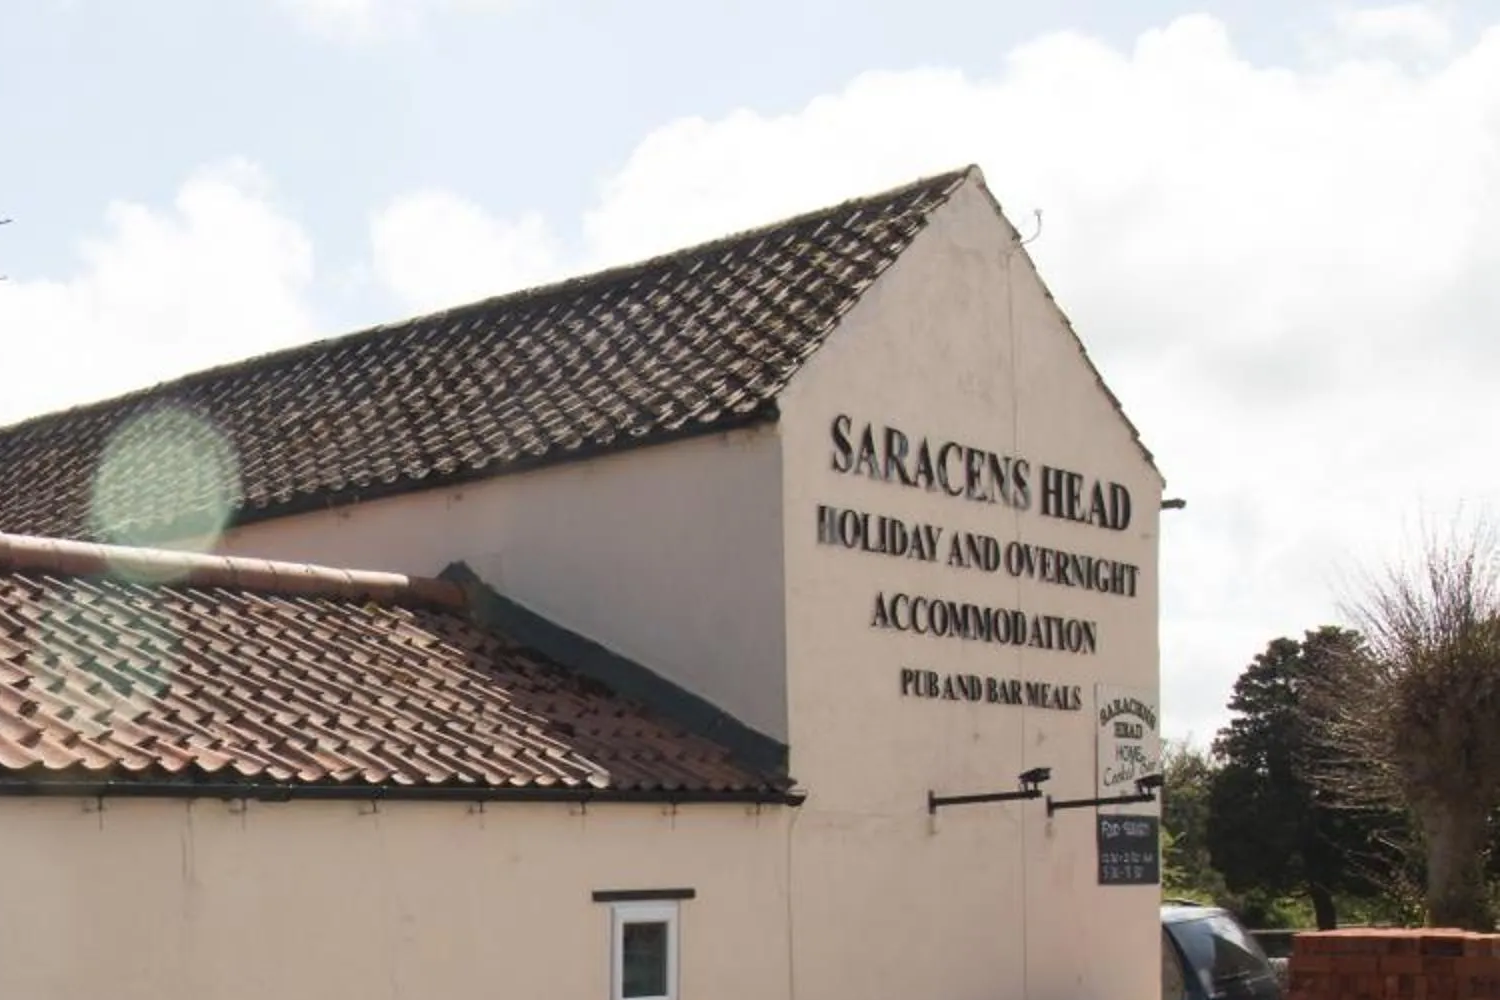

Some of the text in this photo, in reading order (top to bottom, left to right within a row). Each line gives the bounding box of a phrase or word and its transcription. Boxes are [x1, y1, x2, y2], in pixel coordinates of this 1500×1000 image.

[831, 414, 1132, 531] SARACENS HEAD
[817, 504, 1140, 597] HOLIDAY AND OVERNIGHT
[871, 592, 1097, 653] ACCOMMODATION
[901, 668, 1082, 710] PUB AND BAR MEALS
